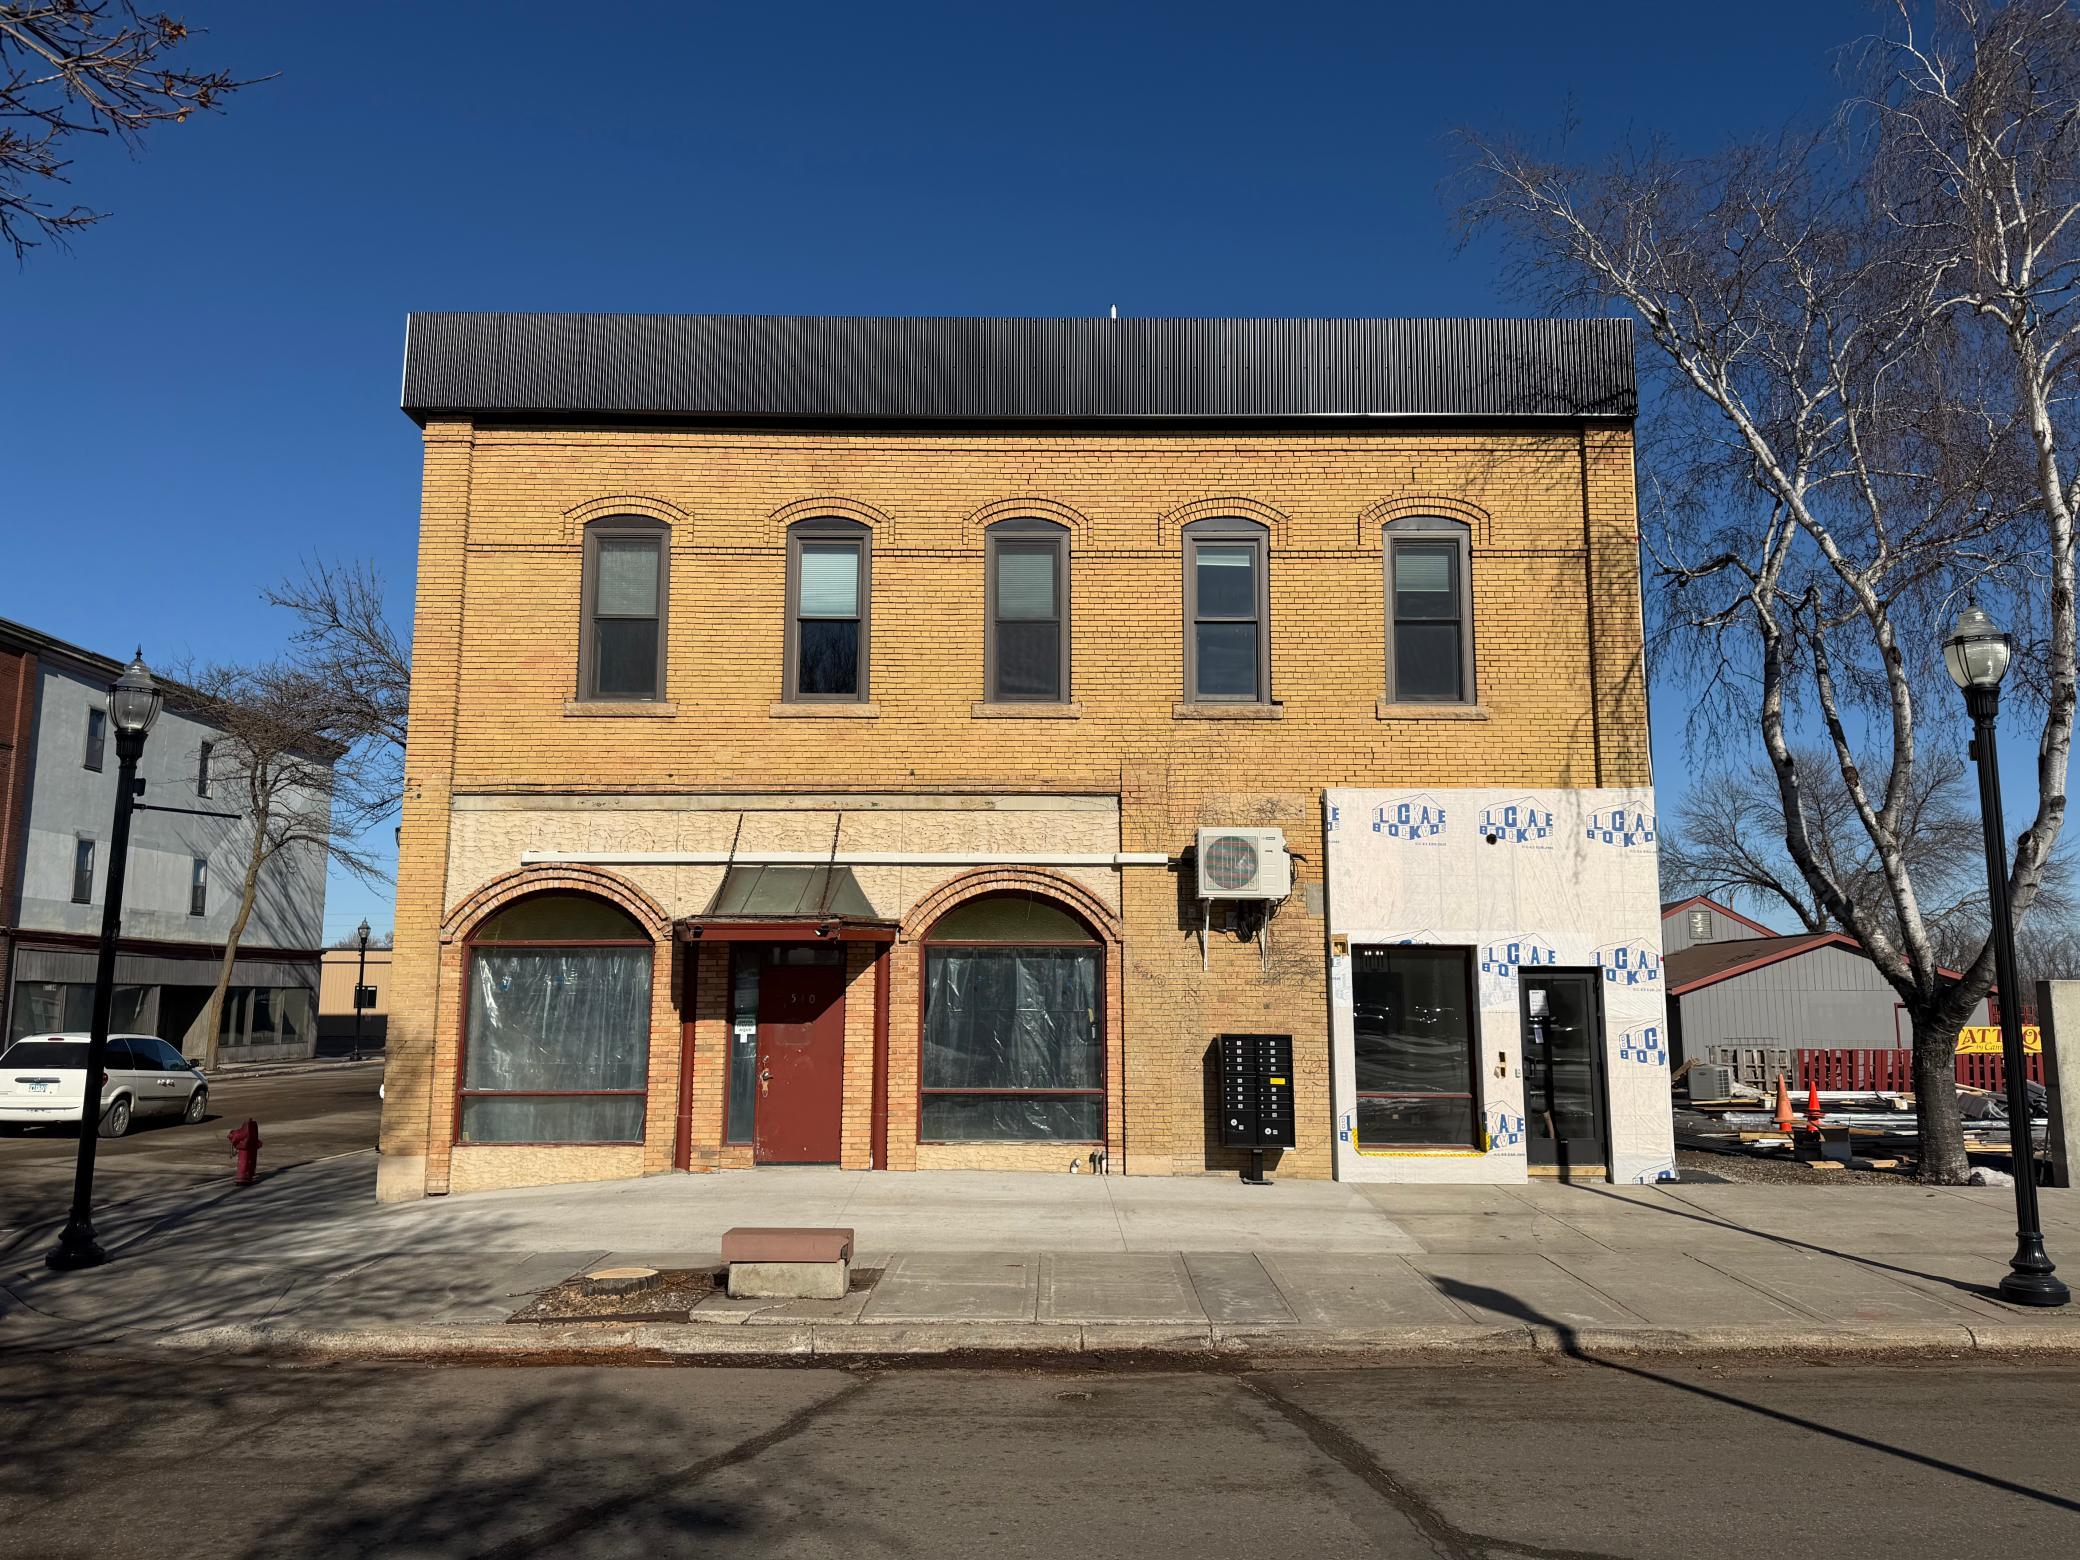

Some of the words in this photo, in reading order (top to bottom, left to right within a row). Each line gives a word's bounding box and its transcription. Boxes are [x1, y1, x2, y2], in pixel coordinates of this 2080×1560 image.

[1372, 803, 1446, 824] BLOCKADE
[1479, 805, 1553, 827] BLOCKADE
[1482, 943, 1555, 965] BLOCKADE
